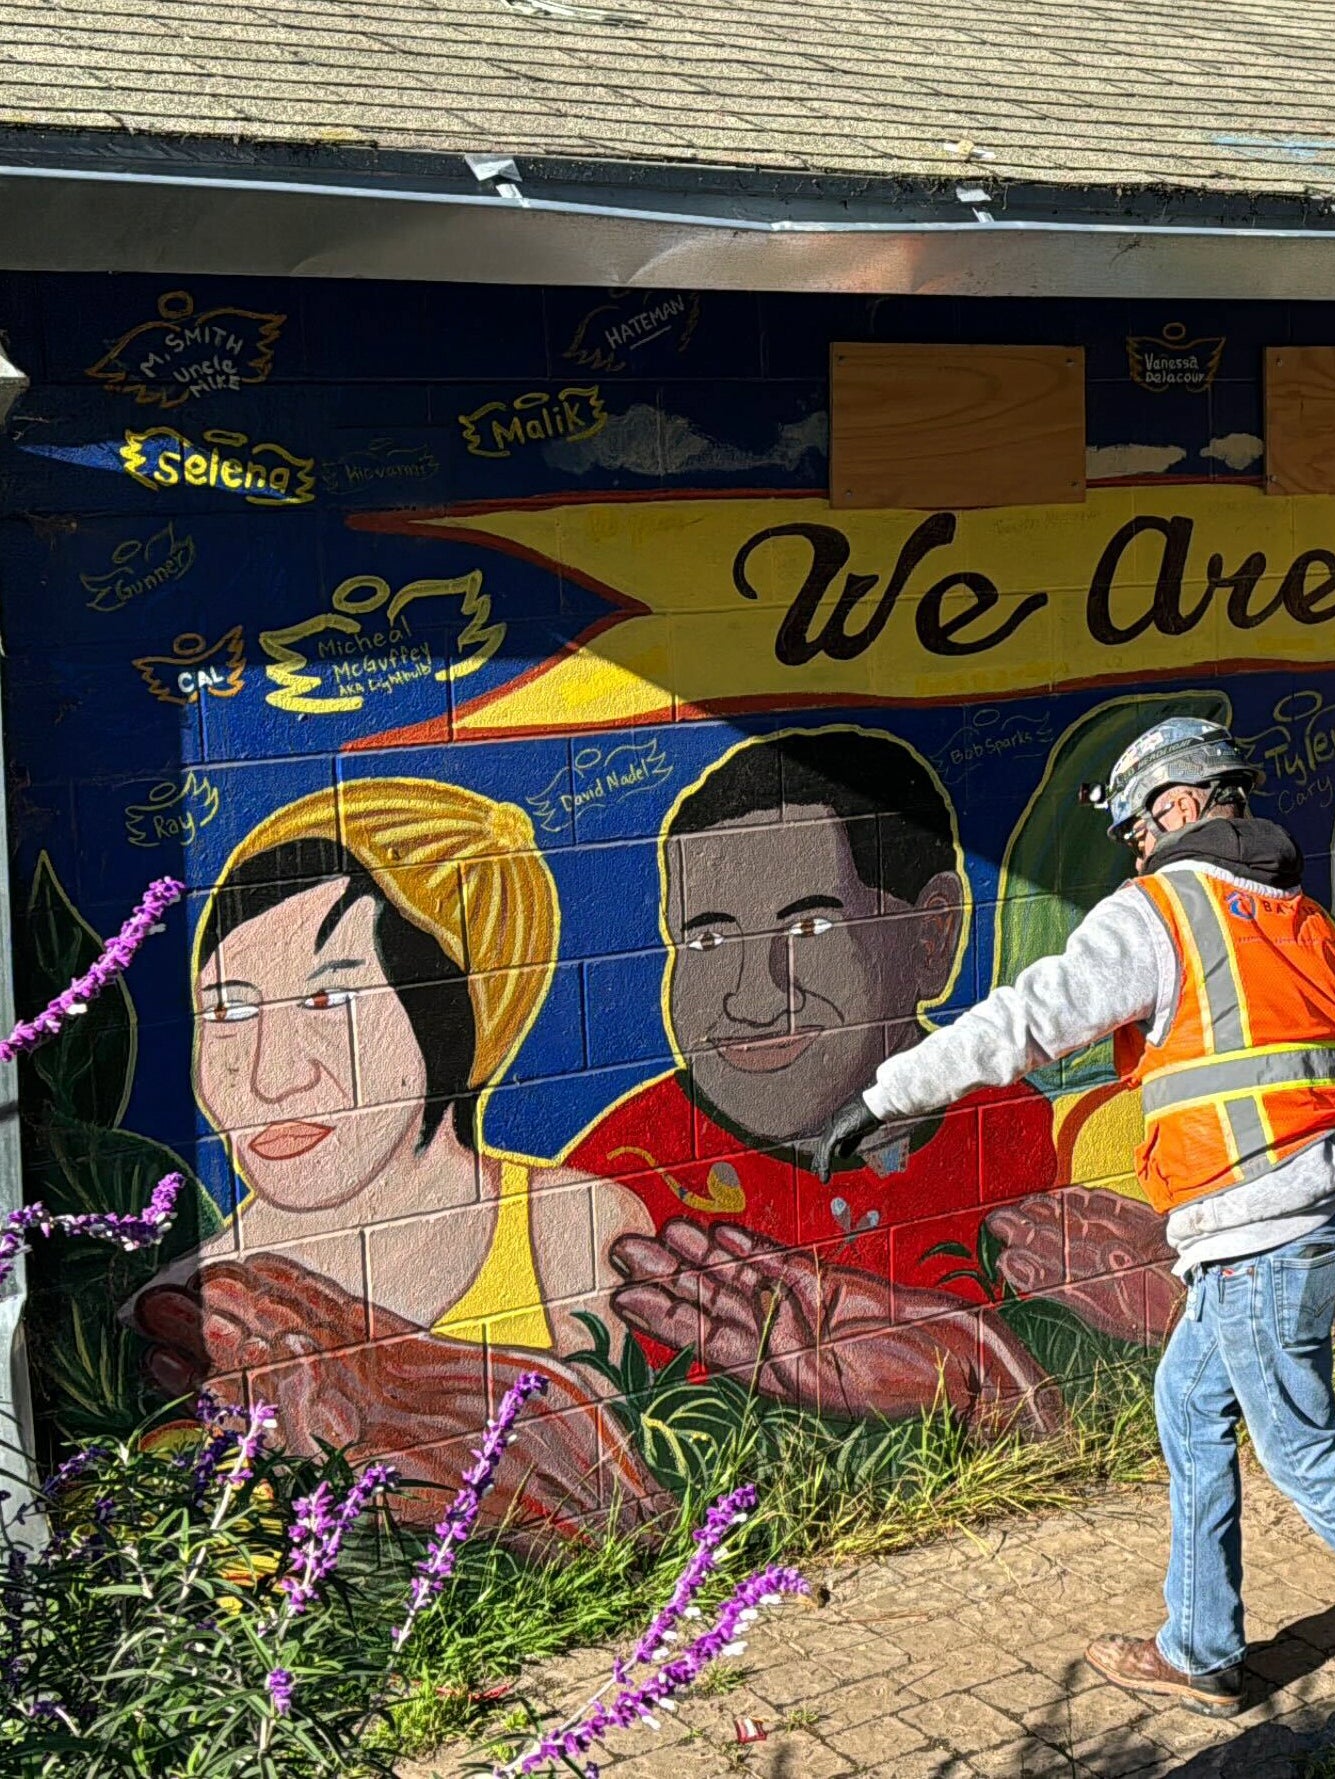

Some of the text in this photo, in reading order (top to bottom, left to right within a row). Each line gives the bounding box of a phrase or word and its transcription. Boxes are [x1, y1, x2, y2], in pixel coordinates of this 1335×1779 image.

[604, 297, 685, 349] HATEMAN
[165, 326, 243, 356] SMITH
[172, 354, 238, 383] Uncle
[1144, 352, 1200, 371] Vanessa
[189, 376, 241, 398] MIKE
[491, 402, 586, 447] Malik
[153, 446, 291, 494] Selena
[733, 512, 1048, 666] We
[318, 615, 412, 658] Micheal
[178, 665, 224, 693] CAL
[951, 731, 1032, 764] Bob Sparks
[561, 758, 650, 812] David Nadel
[154, 811, 196, 846] Ray
